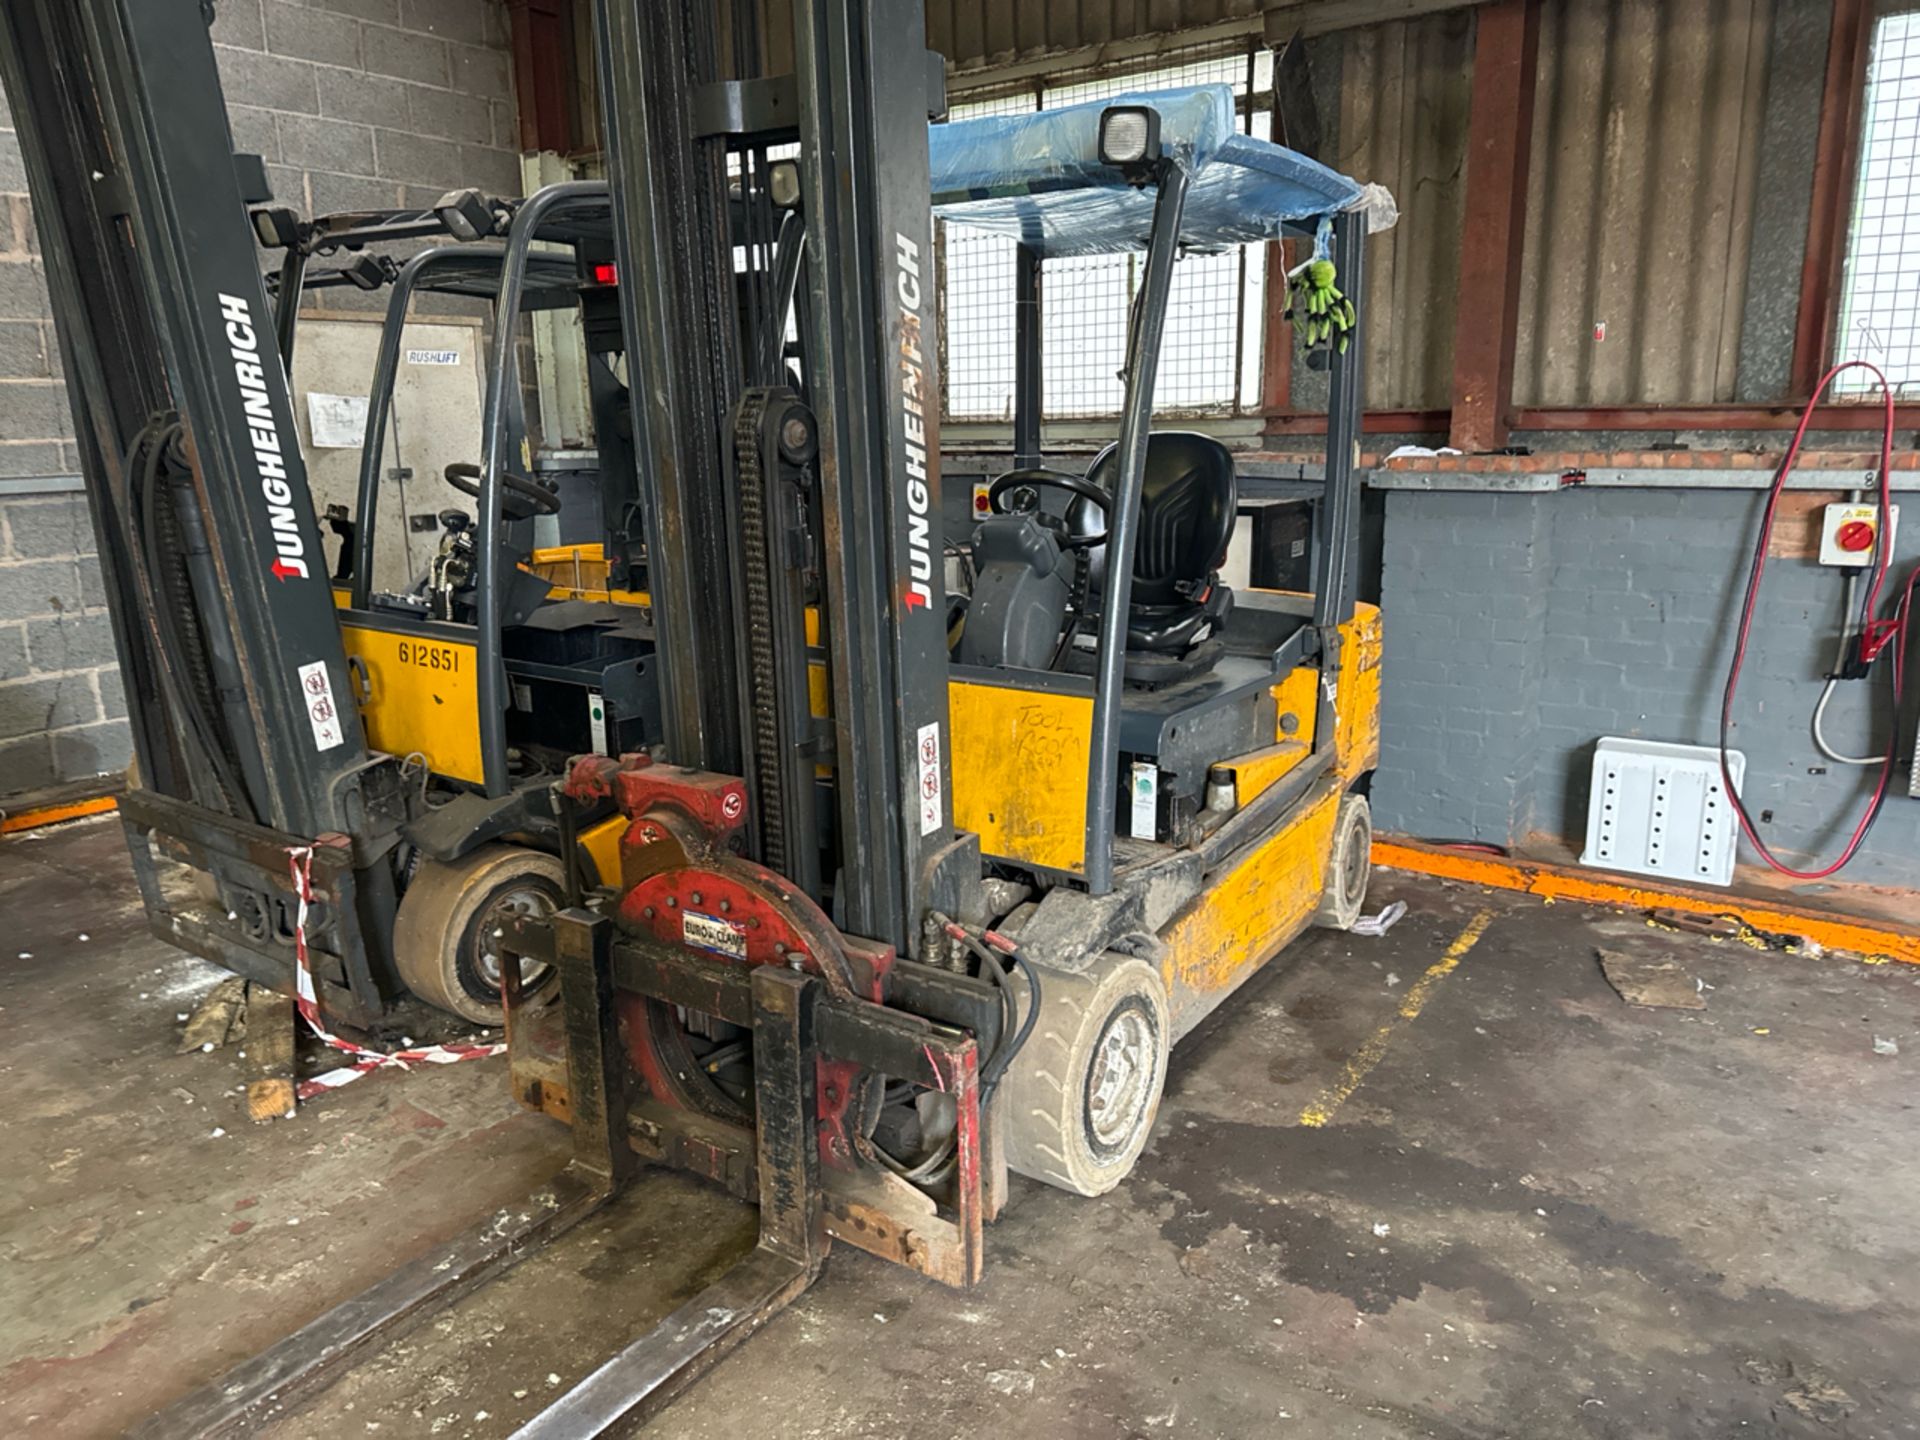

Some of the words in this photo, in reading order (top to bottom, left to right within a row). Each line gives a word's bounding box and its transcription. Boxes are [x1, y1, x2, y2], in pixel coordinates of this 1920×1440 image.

[409, 351, 457, 363] RUSHLIFT
[218, 293, 310, 583] JUNGHEINRICH
[1864, 471, 1875, 488] 8
[398, 641, 459, 673] 612851
[1019, 705, 1073, 731] TOOL
[1016, 730, 1082, 760] ROOM
[685, 921, 707, 938] EURO
